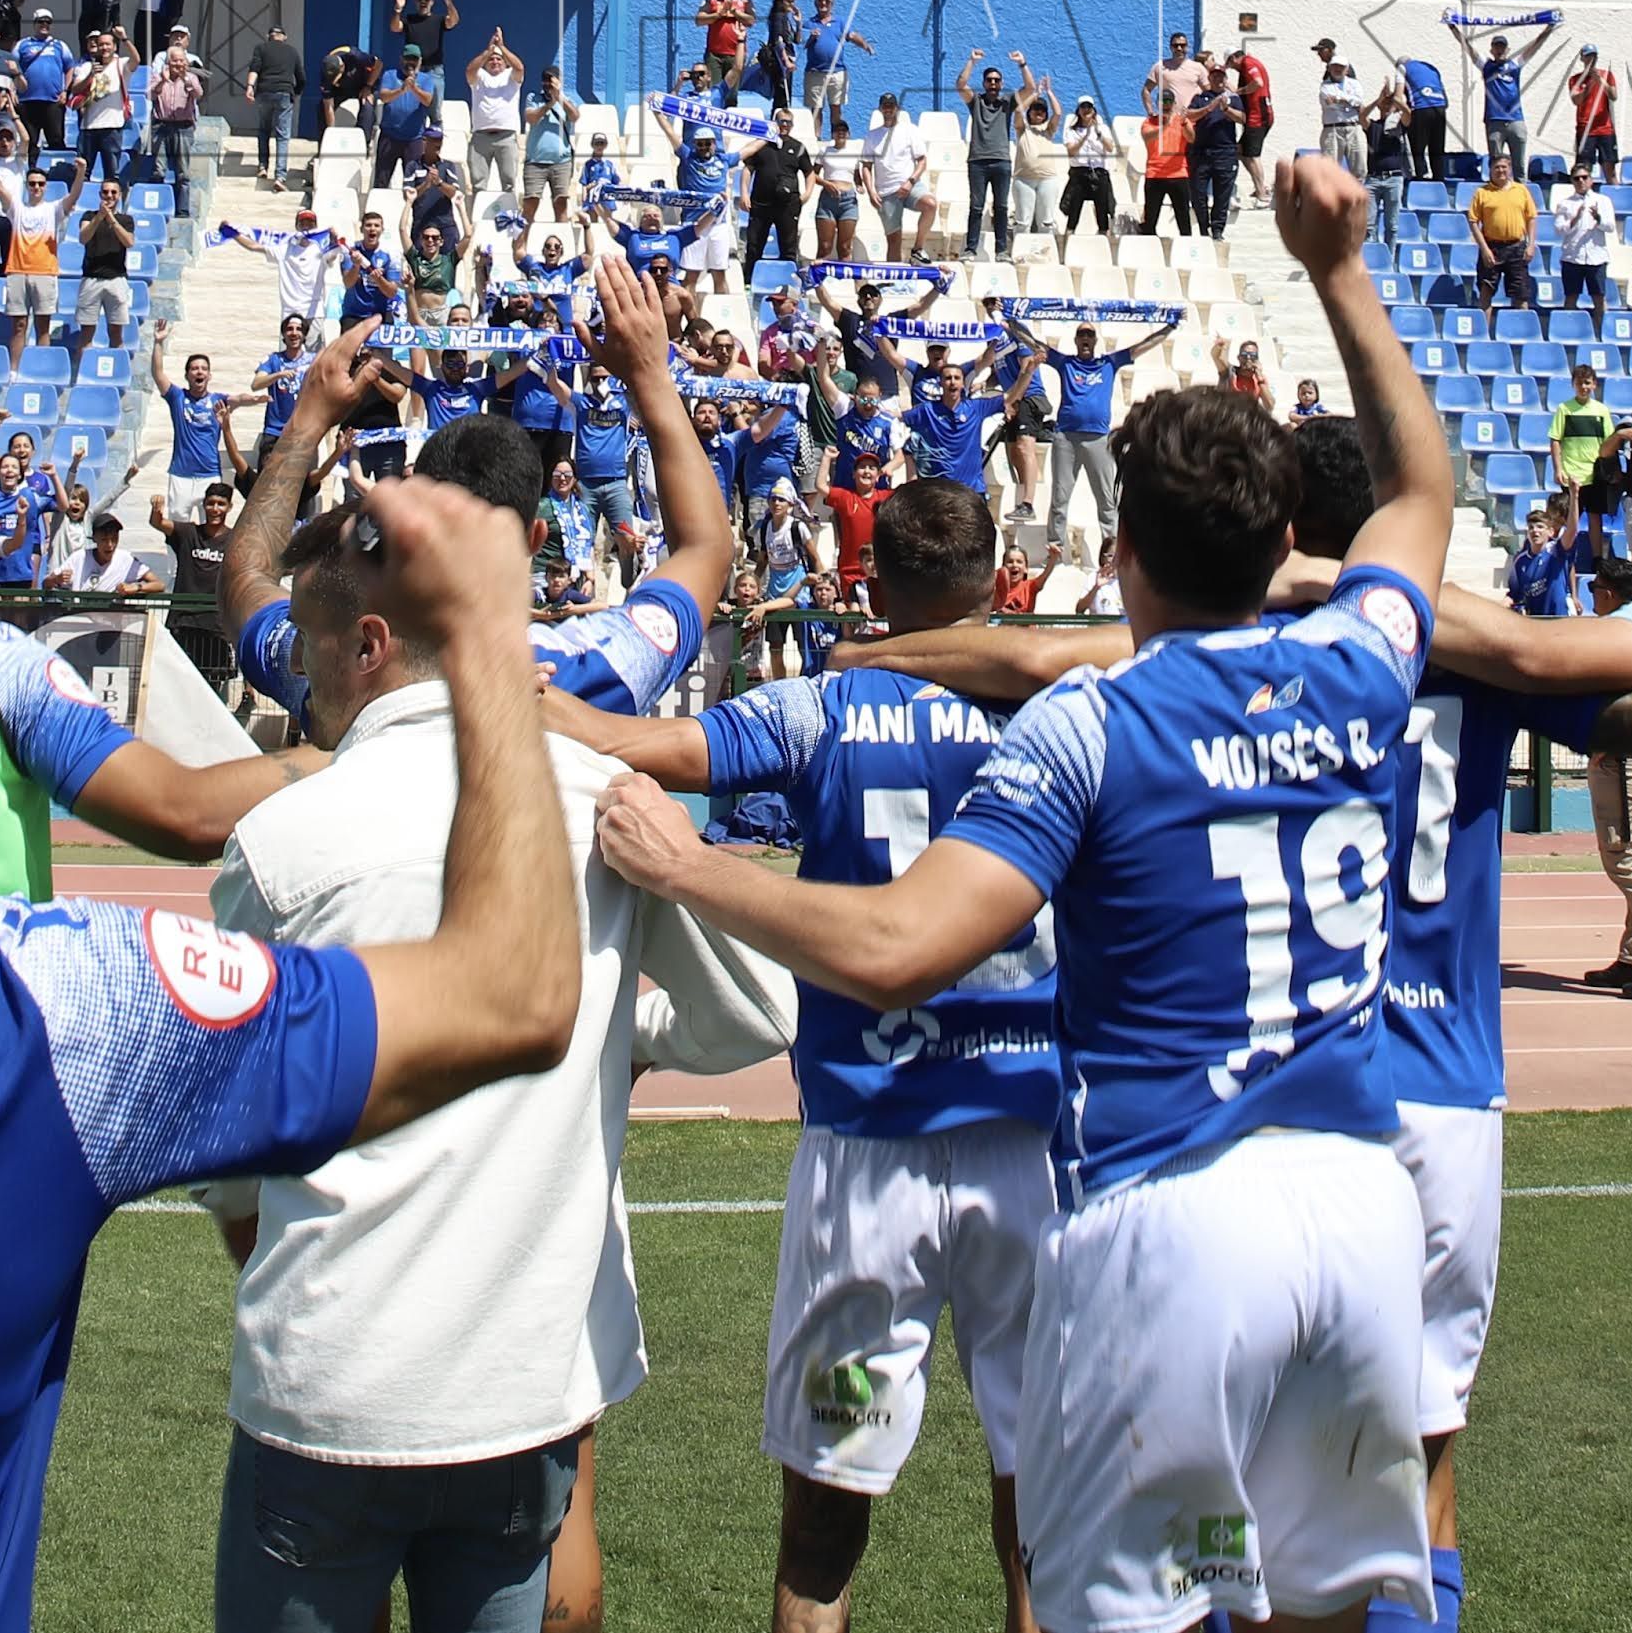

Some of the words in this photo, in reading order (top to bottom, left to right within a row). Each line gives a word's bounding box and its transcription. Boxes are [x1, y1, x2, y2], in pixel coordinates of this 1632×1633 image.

[703, 106, 752, 133] MELILLA
[378, 325, 419, 347] U.D.
[448, 329, 536, 350] MELILLA
[887, 317, 901, 335] U.
[906, 319, 921, 336] D.
[924, 320, 986, 339] MELILLA
[1190, 720, 1344, 790] MOISÉS
[1346, 717, 1387, 770] R.
[1208, 797, 1390, 1060] 19
